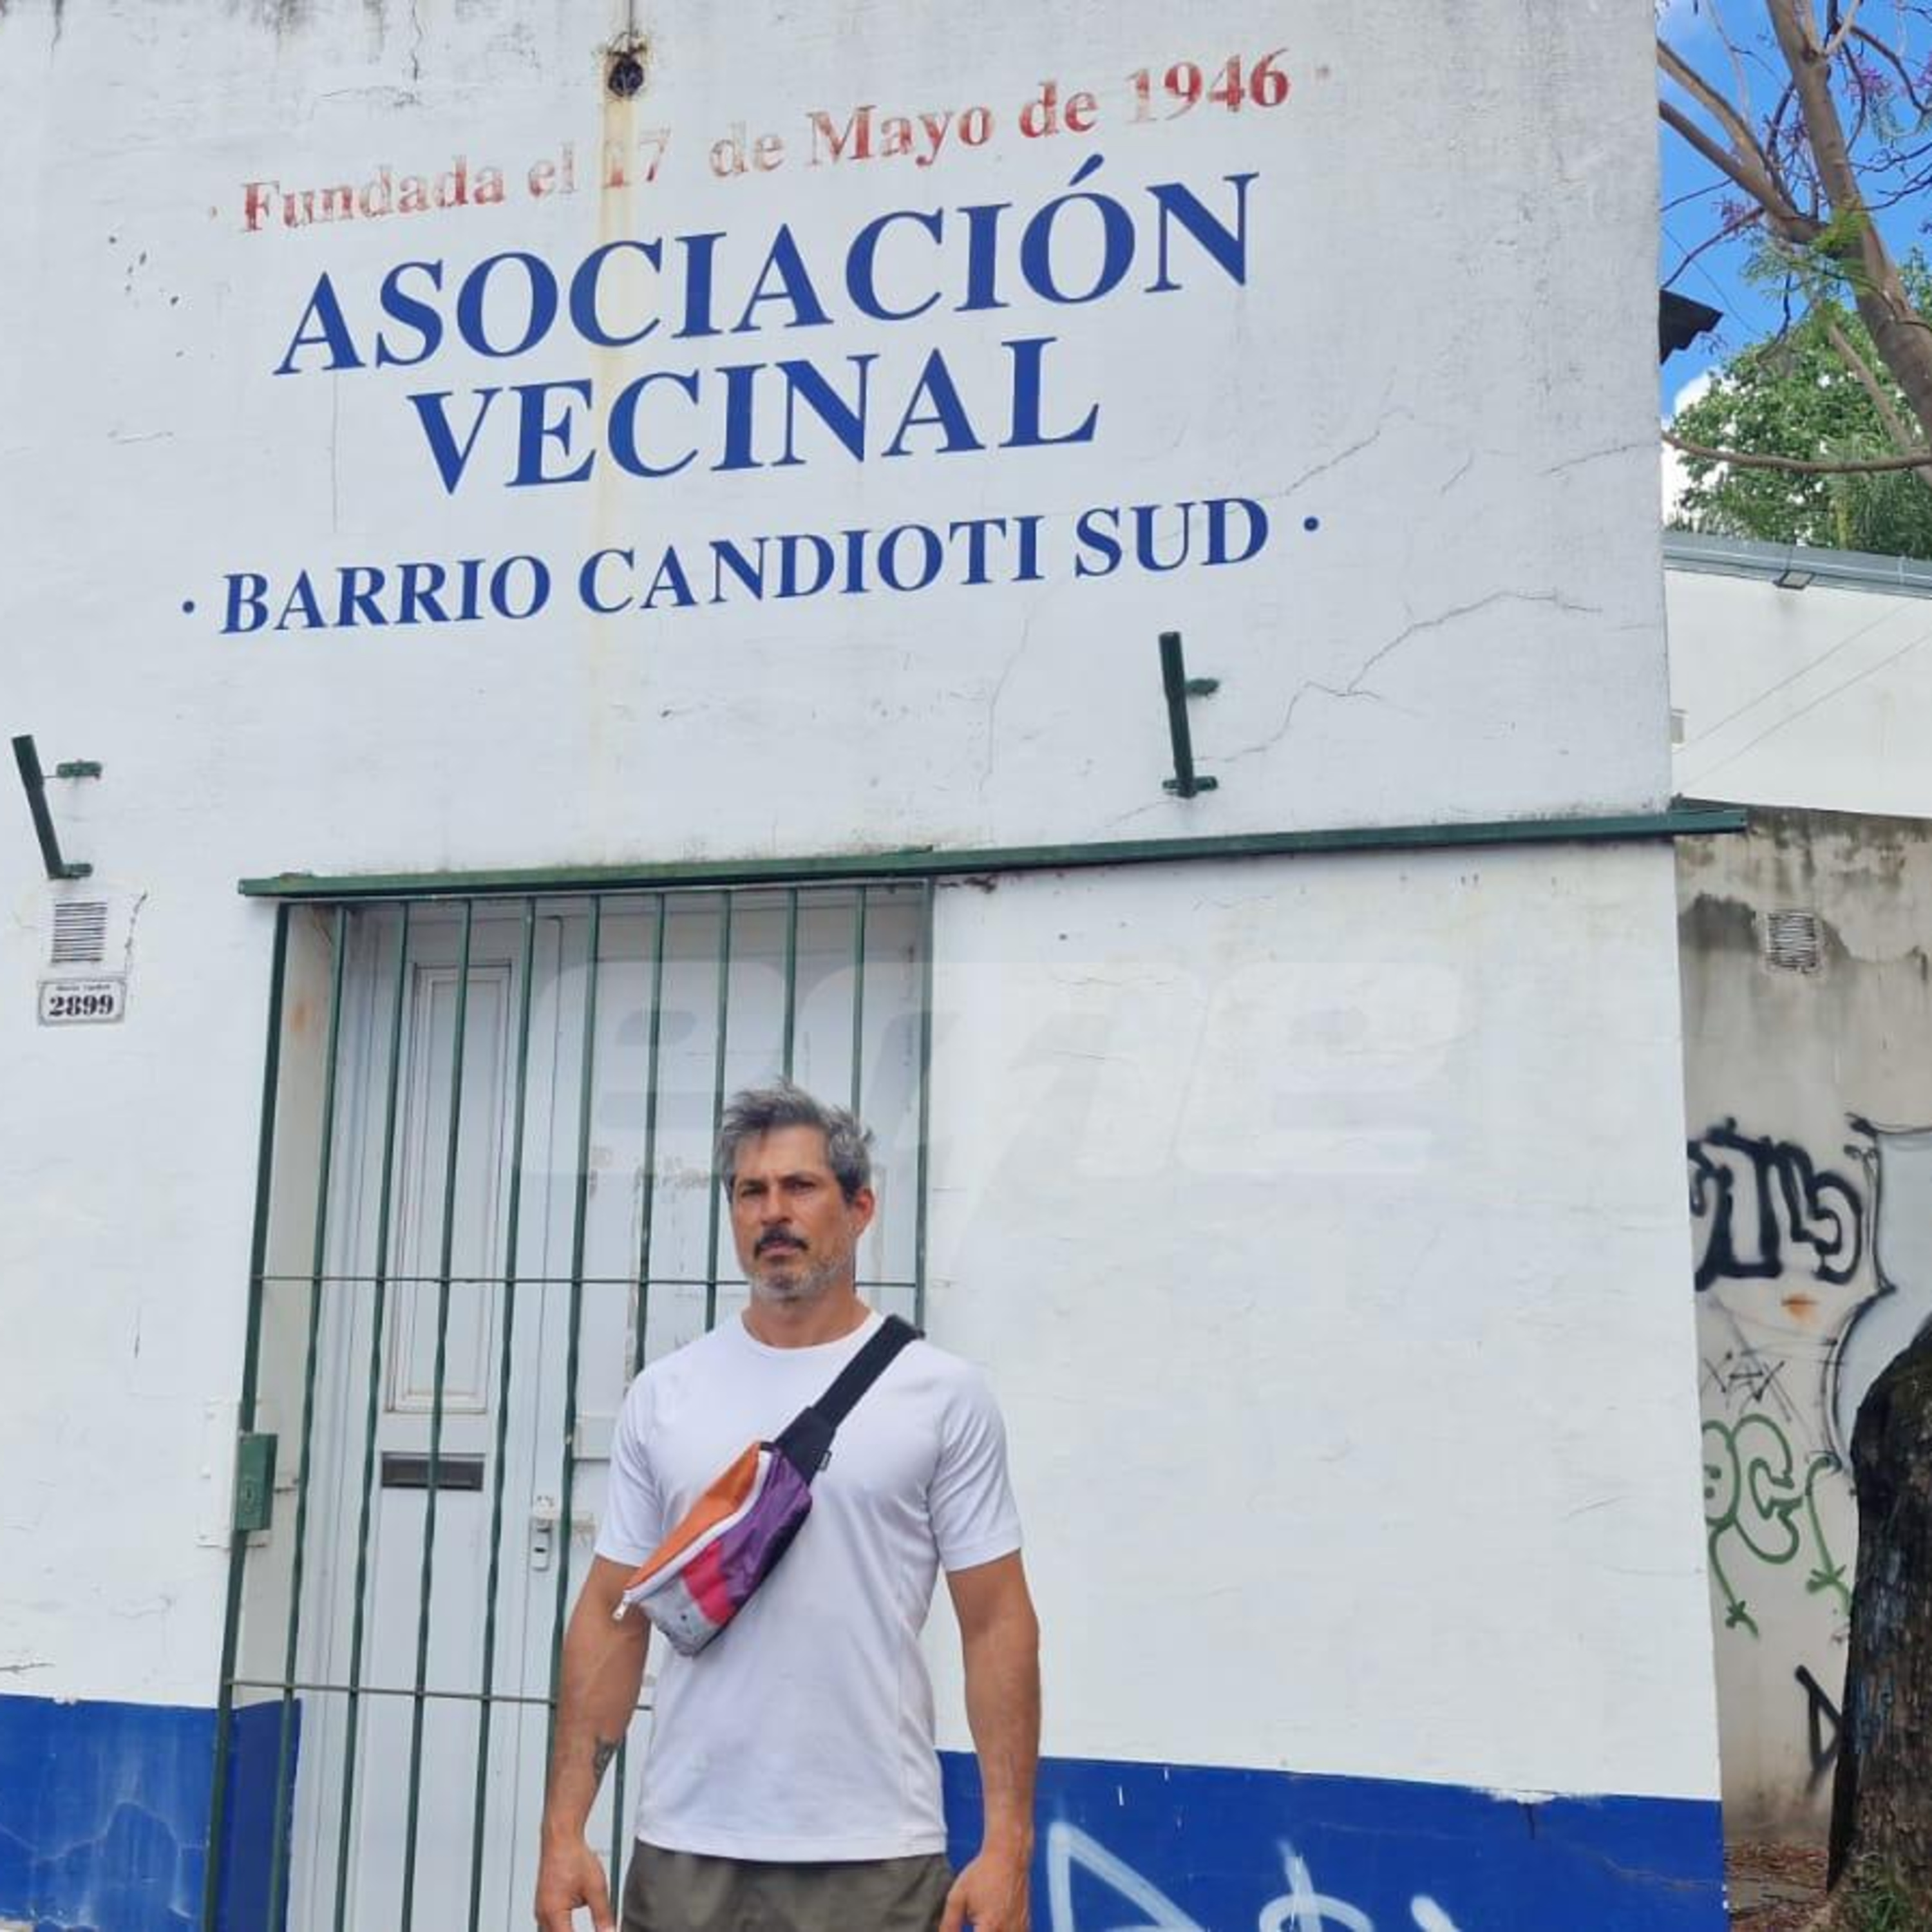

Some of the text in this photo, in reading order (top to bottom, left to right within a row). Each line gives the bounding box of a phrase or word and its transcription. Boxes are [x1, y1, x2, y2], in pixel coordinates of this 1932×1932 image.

[240, 155, 507, 232] Fundada
[527, 141, 578, 198] el
[710, 120, 786, 176] de
[807, 104, 994, 167] Mayo
[1018, 80, 1099, 138] de
[1125, 48, 1291, 125] 1946
[273, 153, 1260, 375] ASOCIACIÓN
[406, 336, 1100, 495] VECINAL
[220, 497, 1269, 634] BARRIO CANDIOTI SUD
[48, 994, 114, 1016] 2899
